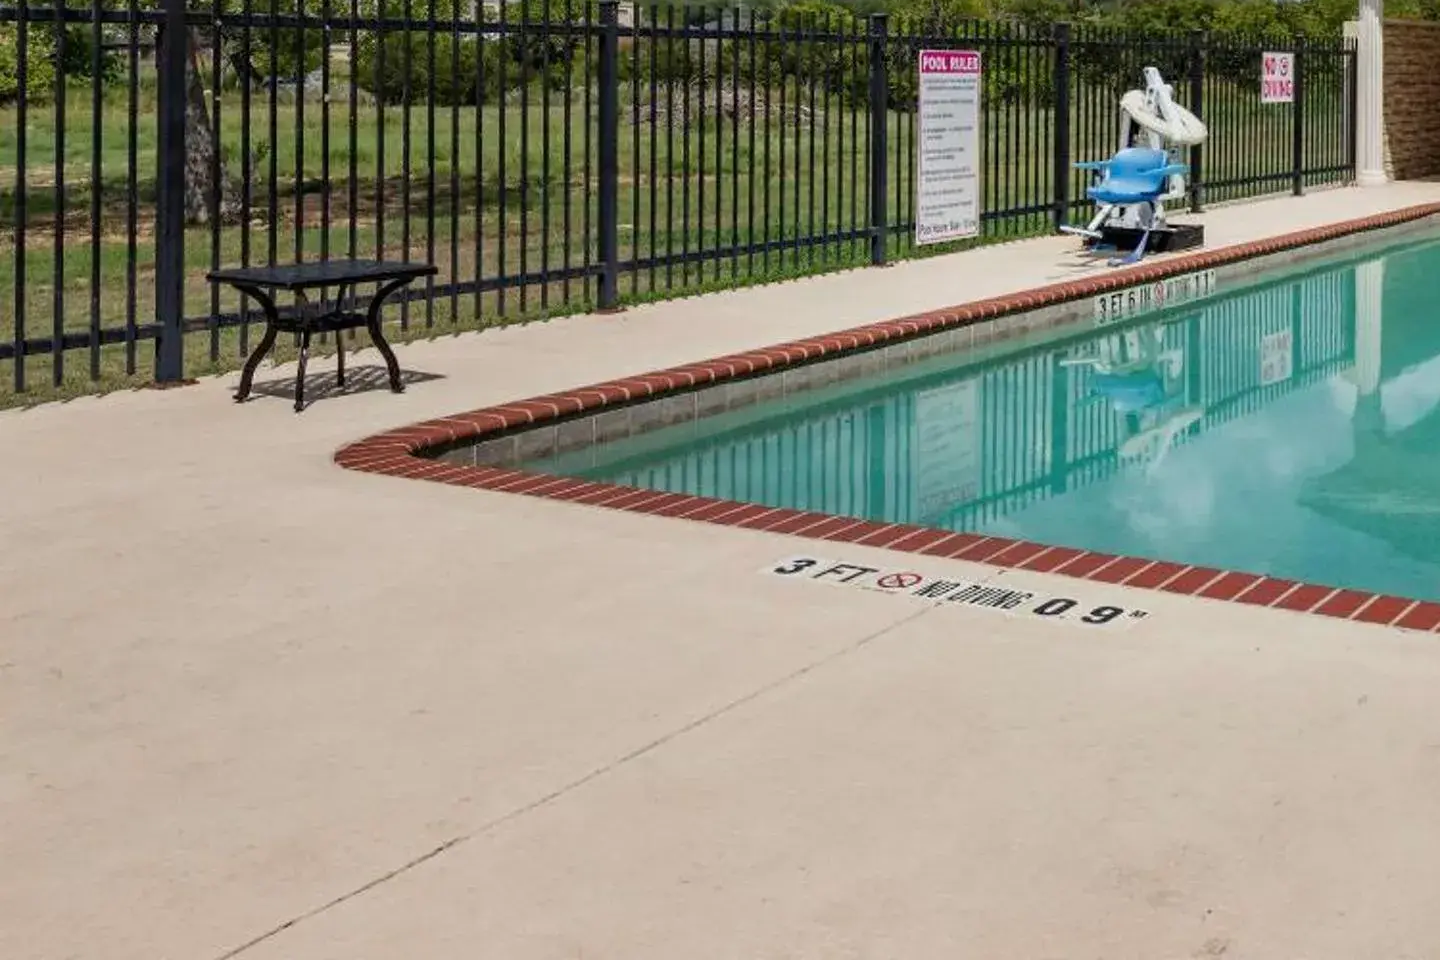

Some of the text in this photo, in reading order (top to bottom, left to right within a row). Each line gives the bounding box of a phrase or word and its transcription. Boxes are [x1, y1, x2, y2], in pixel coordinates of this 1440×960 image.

[923, 56, 978, 71] POOL RULES
[773, 558, 817, 575] 3
[813, 563, 880, 583] FT
[913, 580, 960, 598] NO
[947, 585, 1033, 610] DIVING
